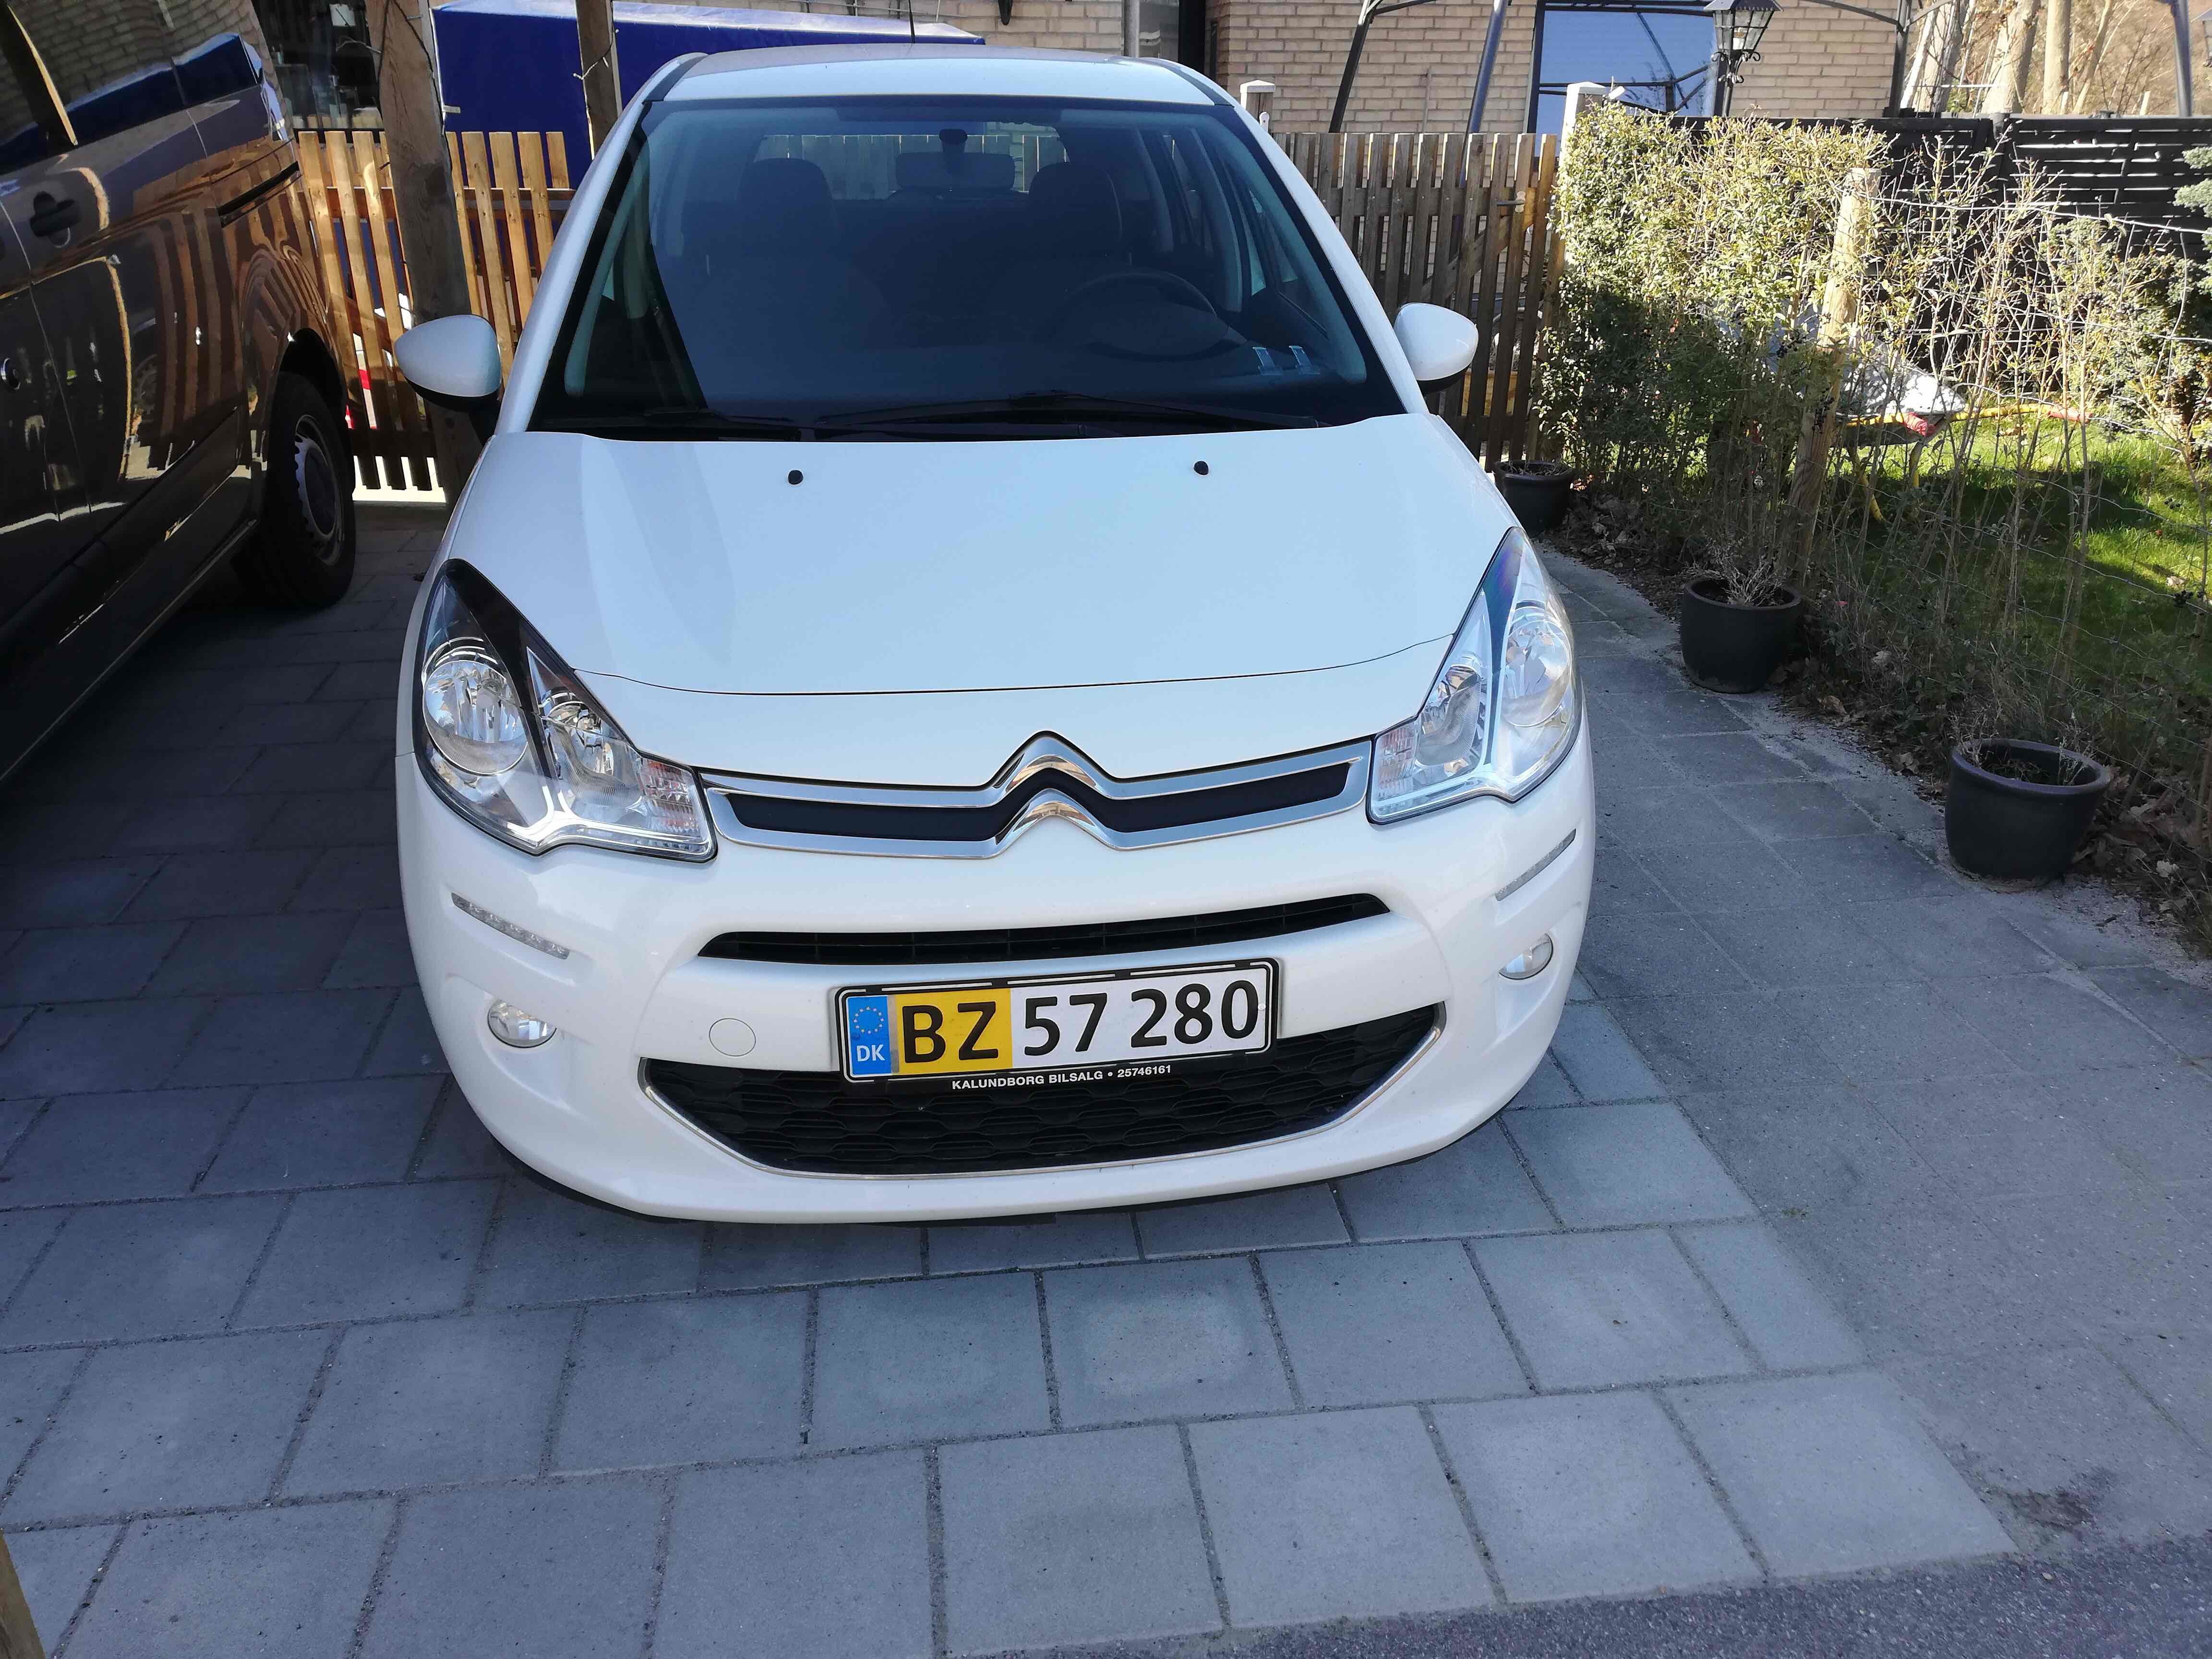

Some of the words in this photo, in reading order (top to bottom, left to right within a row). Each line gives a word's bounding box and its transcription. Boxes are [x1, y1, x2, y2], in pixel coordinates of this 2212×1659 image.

[902, 1001, 999, 1063] BZ
[1024, 993, 1108, 1056] 57
[1131, 980, 1259, 1048] 280
[857, 1045, 885, 1062] DK
[951, 1075, 1045, 1090] KALUNDBORG
[1048, 1071, 1103, 1084] BILSALG
[1117, 1064, 1172, 1078] 25746161
